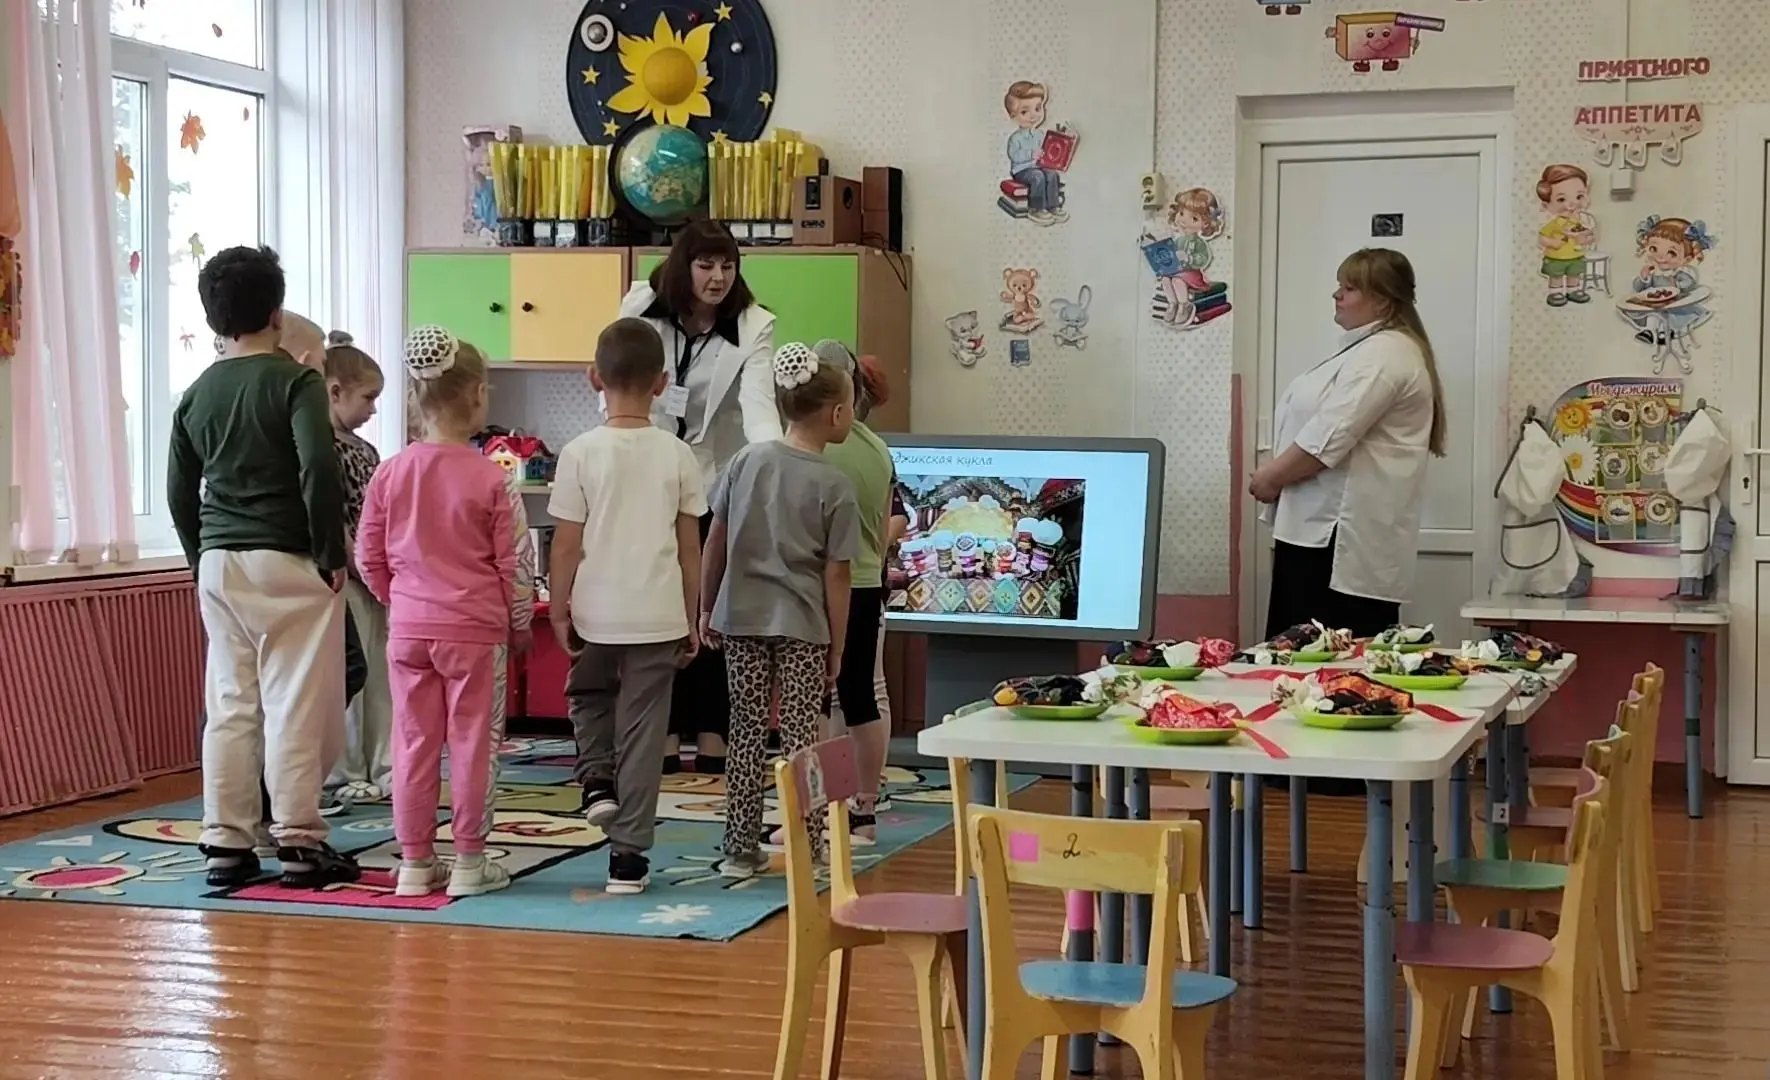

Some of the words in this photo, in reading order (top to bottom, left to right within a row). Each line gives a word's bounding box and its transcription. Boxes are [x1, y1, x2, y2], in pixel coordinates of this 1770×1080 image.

[1578, 57, 1711, 78] ПРИЯТНОГО
[1574, 104, 1702, 125] АППЕТИТА
[894, 452, 952, 465] джикская
[956, 456, 993, 467] кукла
[1063, 833, 1081, 859] 2
